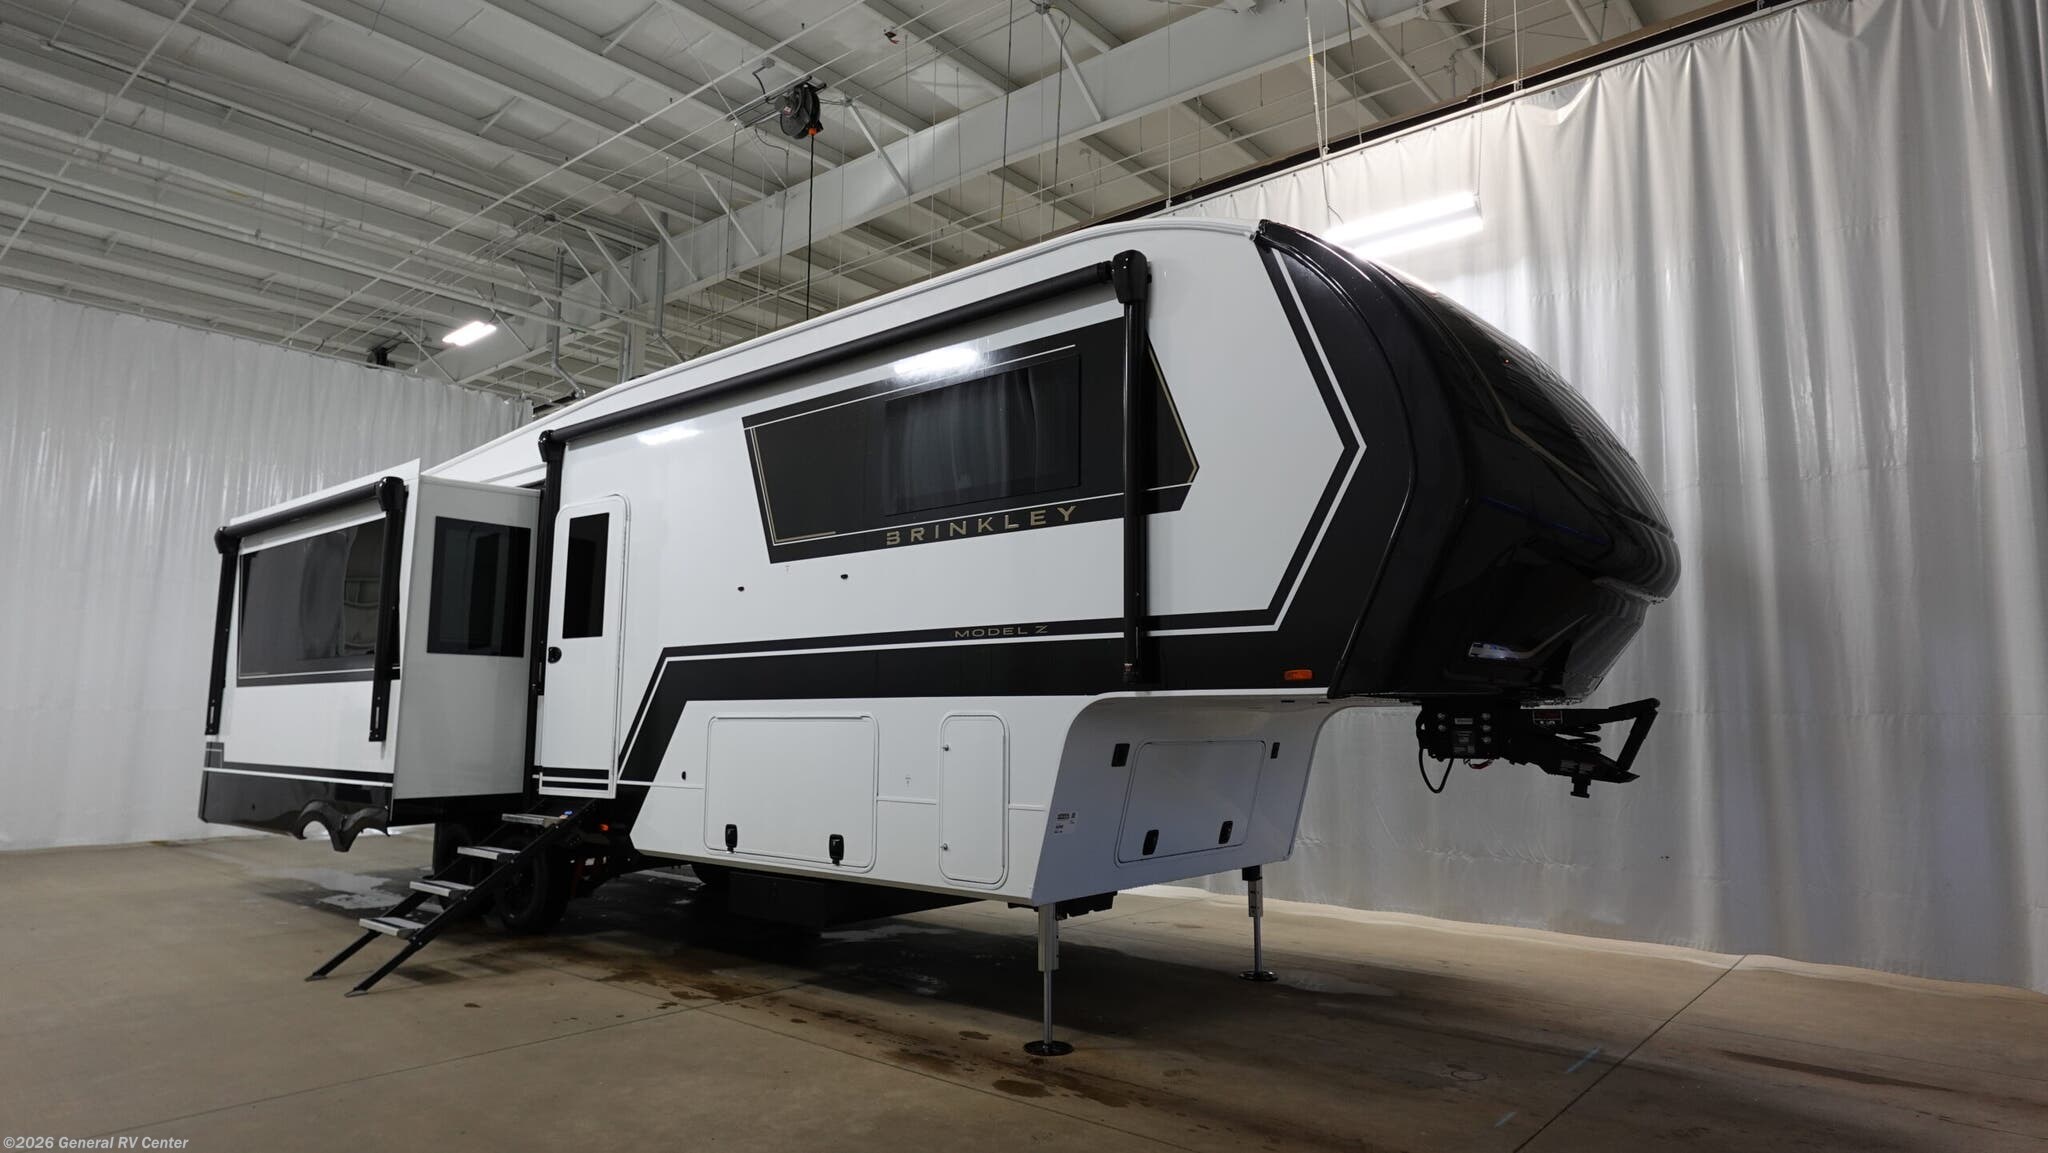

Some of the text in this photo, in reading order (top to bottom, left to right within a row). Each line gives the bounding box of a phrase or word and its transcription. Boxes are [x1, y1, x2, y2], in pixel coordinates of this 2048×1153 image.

[886, 505, 1077, 546] BRINKLEY
[954, 625, 1049, 639] MODEL Z
